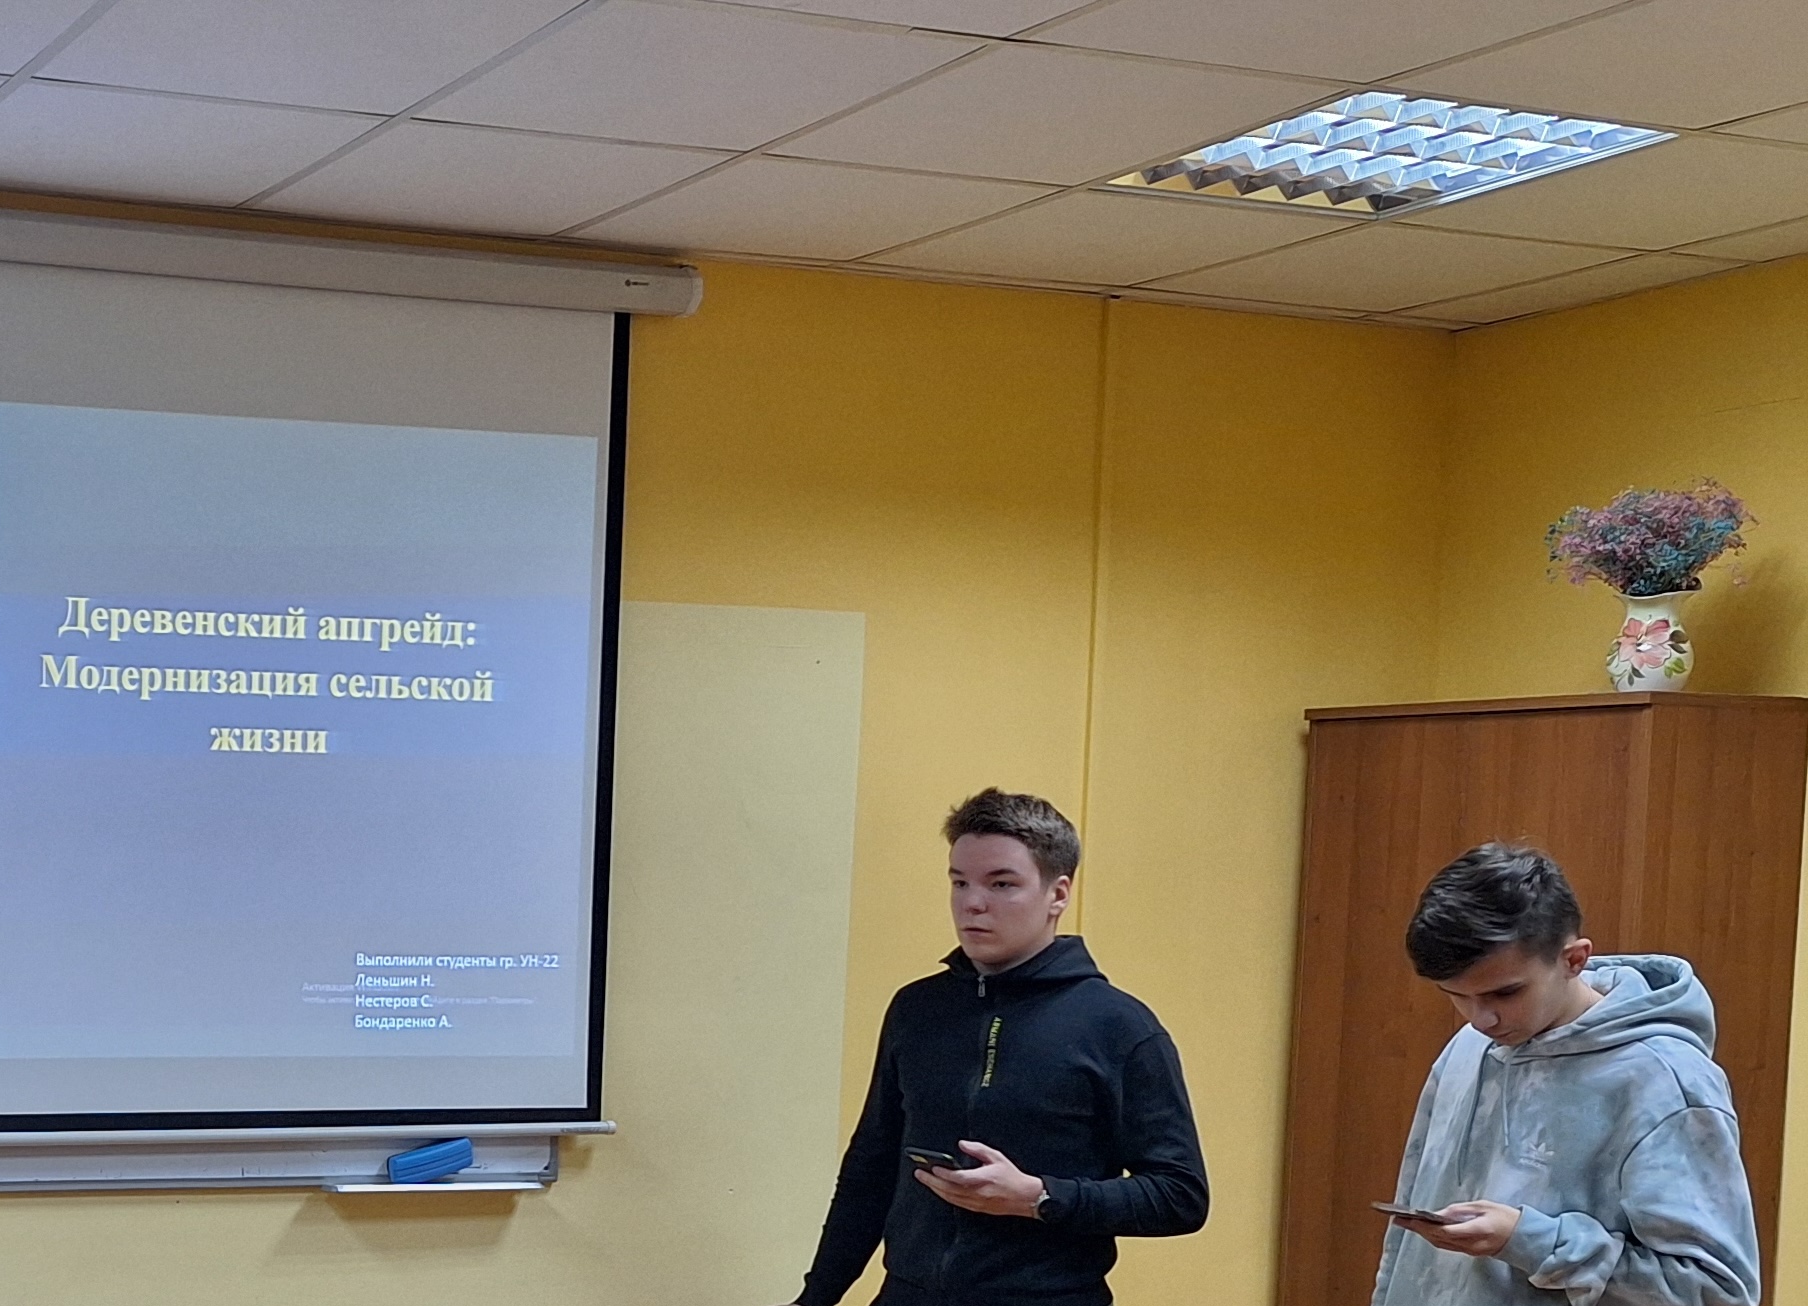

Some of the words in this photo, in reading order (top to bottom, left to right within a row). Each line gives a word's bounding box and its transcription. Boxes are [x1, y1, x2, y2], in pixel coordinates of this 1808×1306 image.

[58, 597, 307, 641] Деревенский
[318, 613, 476, 651] апгрейд:
[40, 654, 318, 700] Модернизация
[330, 671, 494, 702] сельской
[210, 726, 328, 753] жизни
[356, 953, 433, 967] Выполнили
[436, 955, 496, 970] студенты
[500, 957, 517, 970] гр.
[520, 955, 559, 968] УН-22
[355, 974, 418, 987] Леньшин
[421, 974, 435, 987] Н.
[355, 995, 418, 1009] Нестеров
[421, 995, 433, 1007] С.
[355, 1015, 435, 1029] Бондаренко
[439, 1015, 452, 1028] А.
